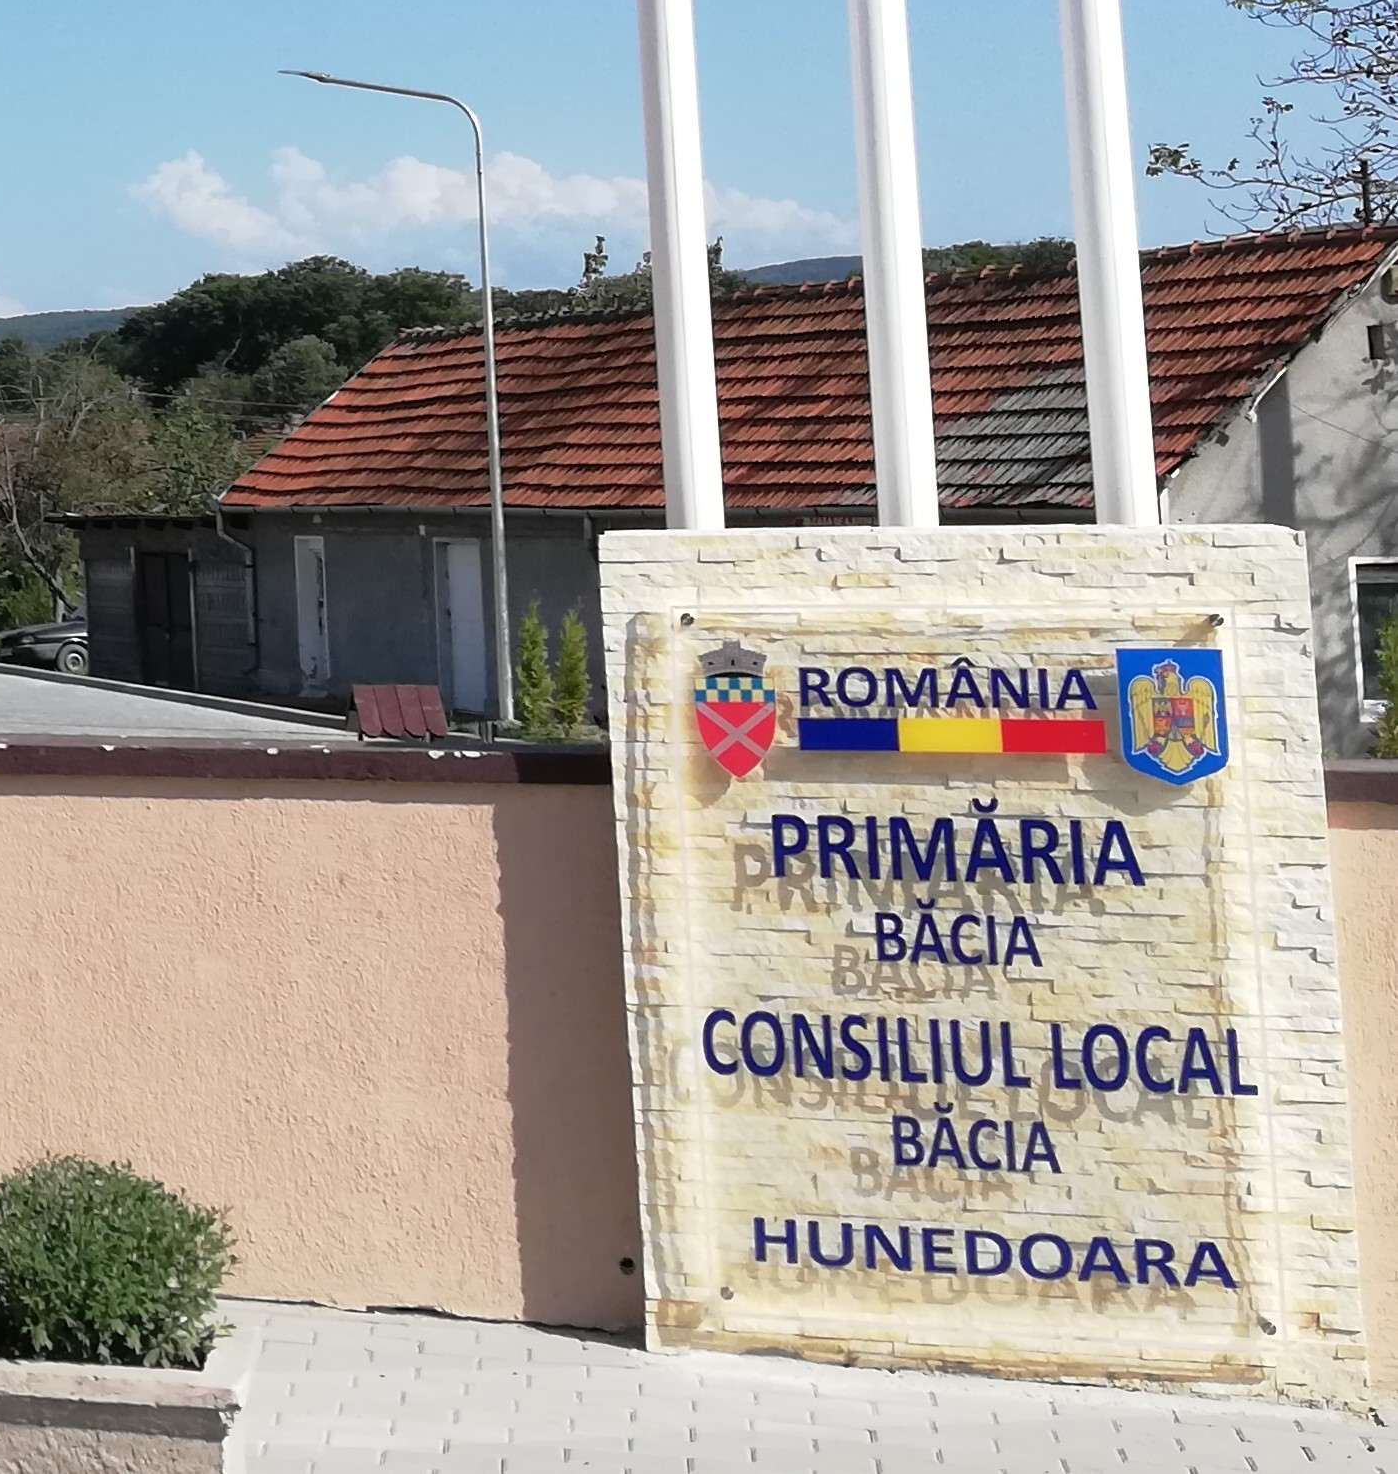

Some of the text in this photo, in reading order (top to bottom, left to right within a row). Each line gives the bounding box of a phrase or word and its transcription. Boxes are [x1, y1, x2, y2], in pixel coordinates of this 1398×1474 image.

[798, 656, 1098, 711] ROMÂNIA
[770, 796, 1146, 887] PRIMĂRIA
[874, 898, 1044, 968] BĂCIA
[702, 1008, 1259, 1096] CONSILIUL LOCAL
[891, 1101, 1063, 1174] BĂCIA
[752, 1216, 1240, 1290] HUNEDOARA
